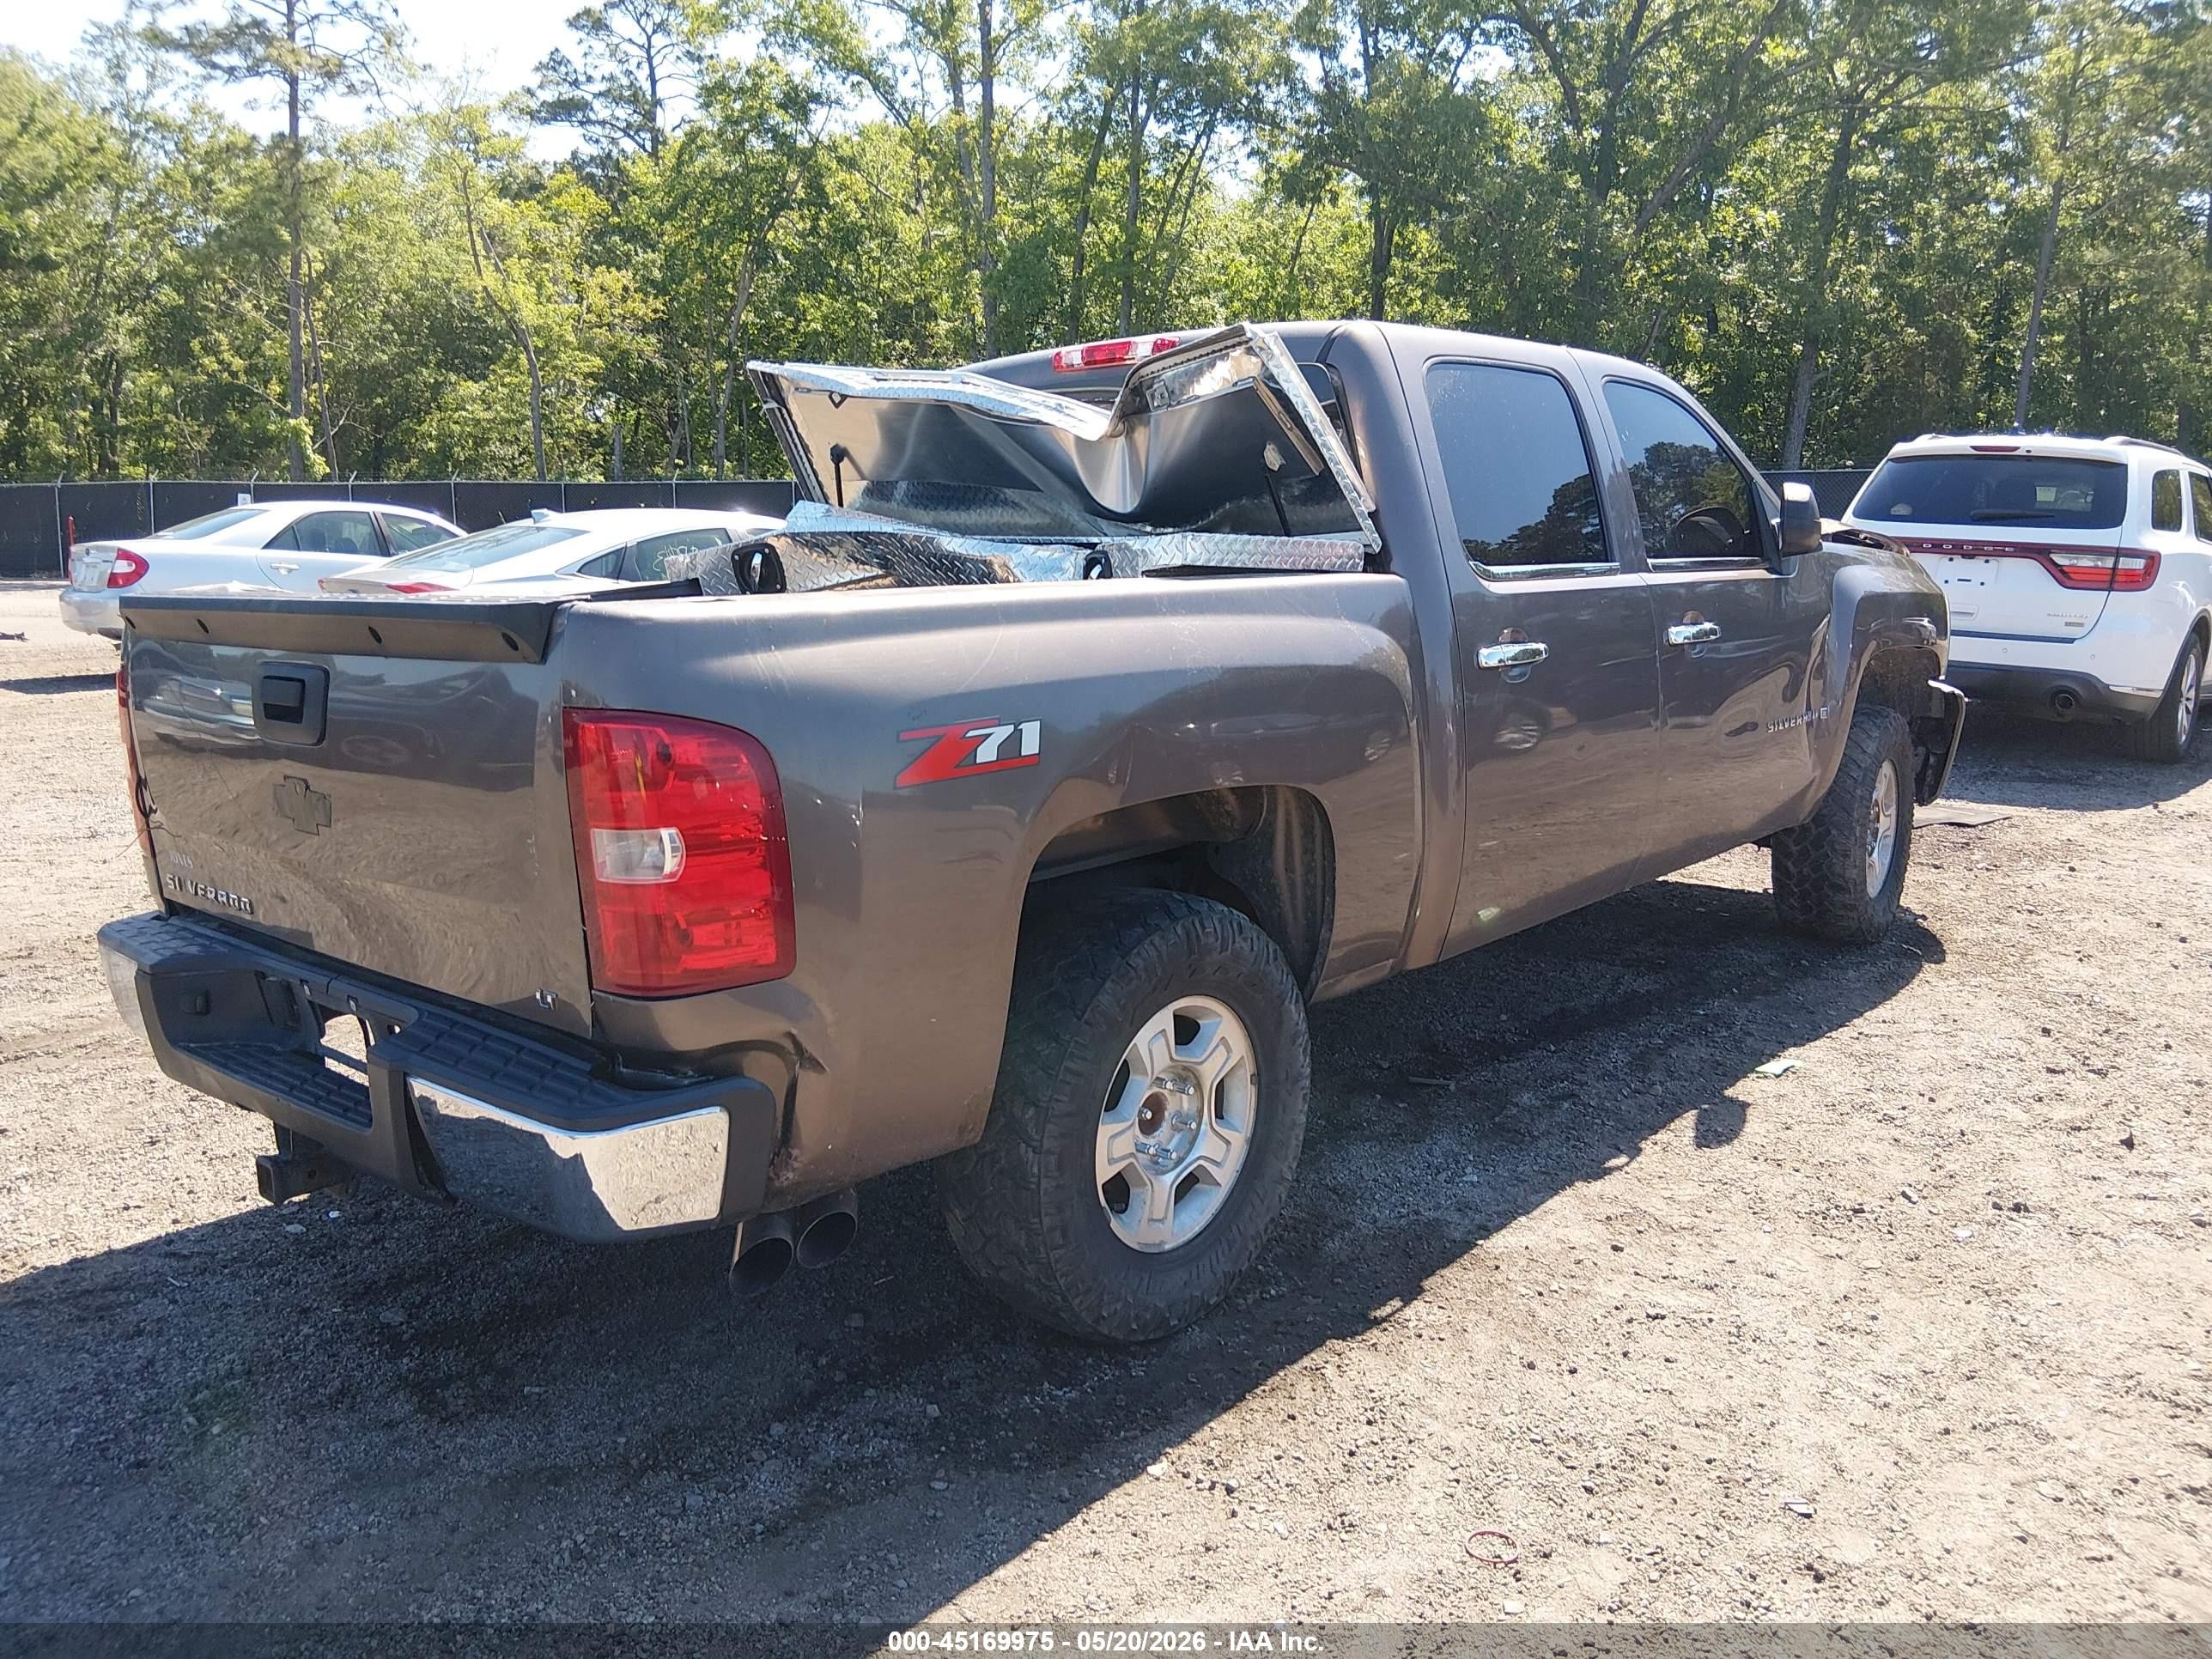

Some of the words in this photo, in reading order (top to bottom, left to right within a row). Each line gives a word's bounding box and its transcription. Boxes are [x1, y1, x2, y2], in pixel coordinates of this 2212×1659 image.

[893, 714, 1042, 791] Z71
[166, 872, 254, 915] SIVERADO
[535, 988, 558, 1011] LT
